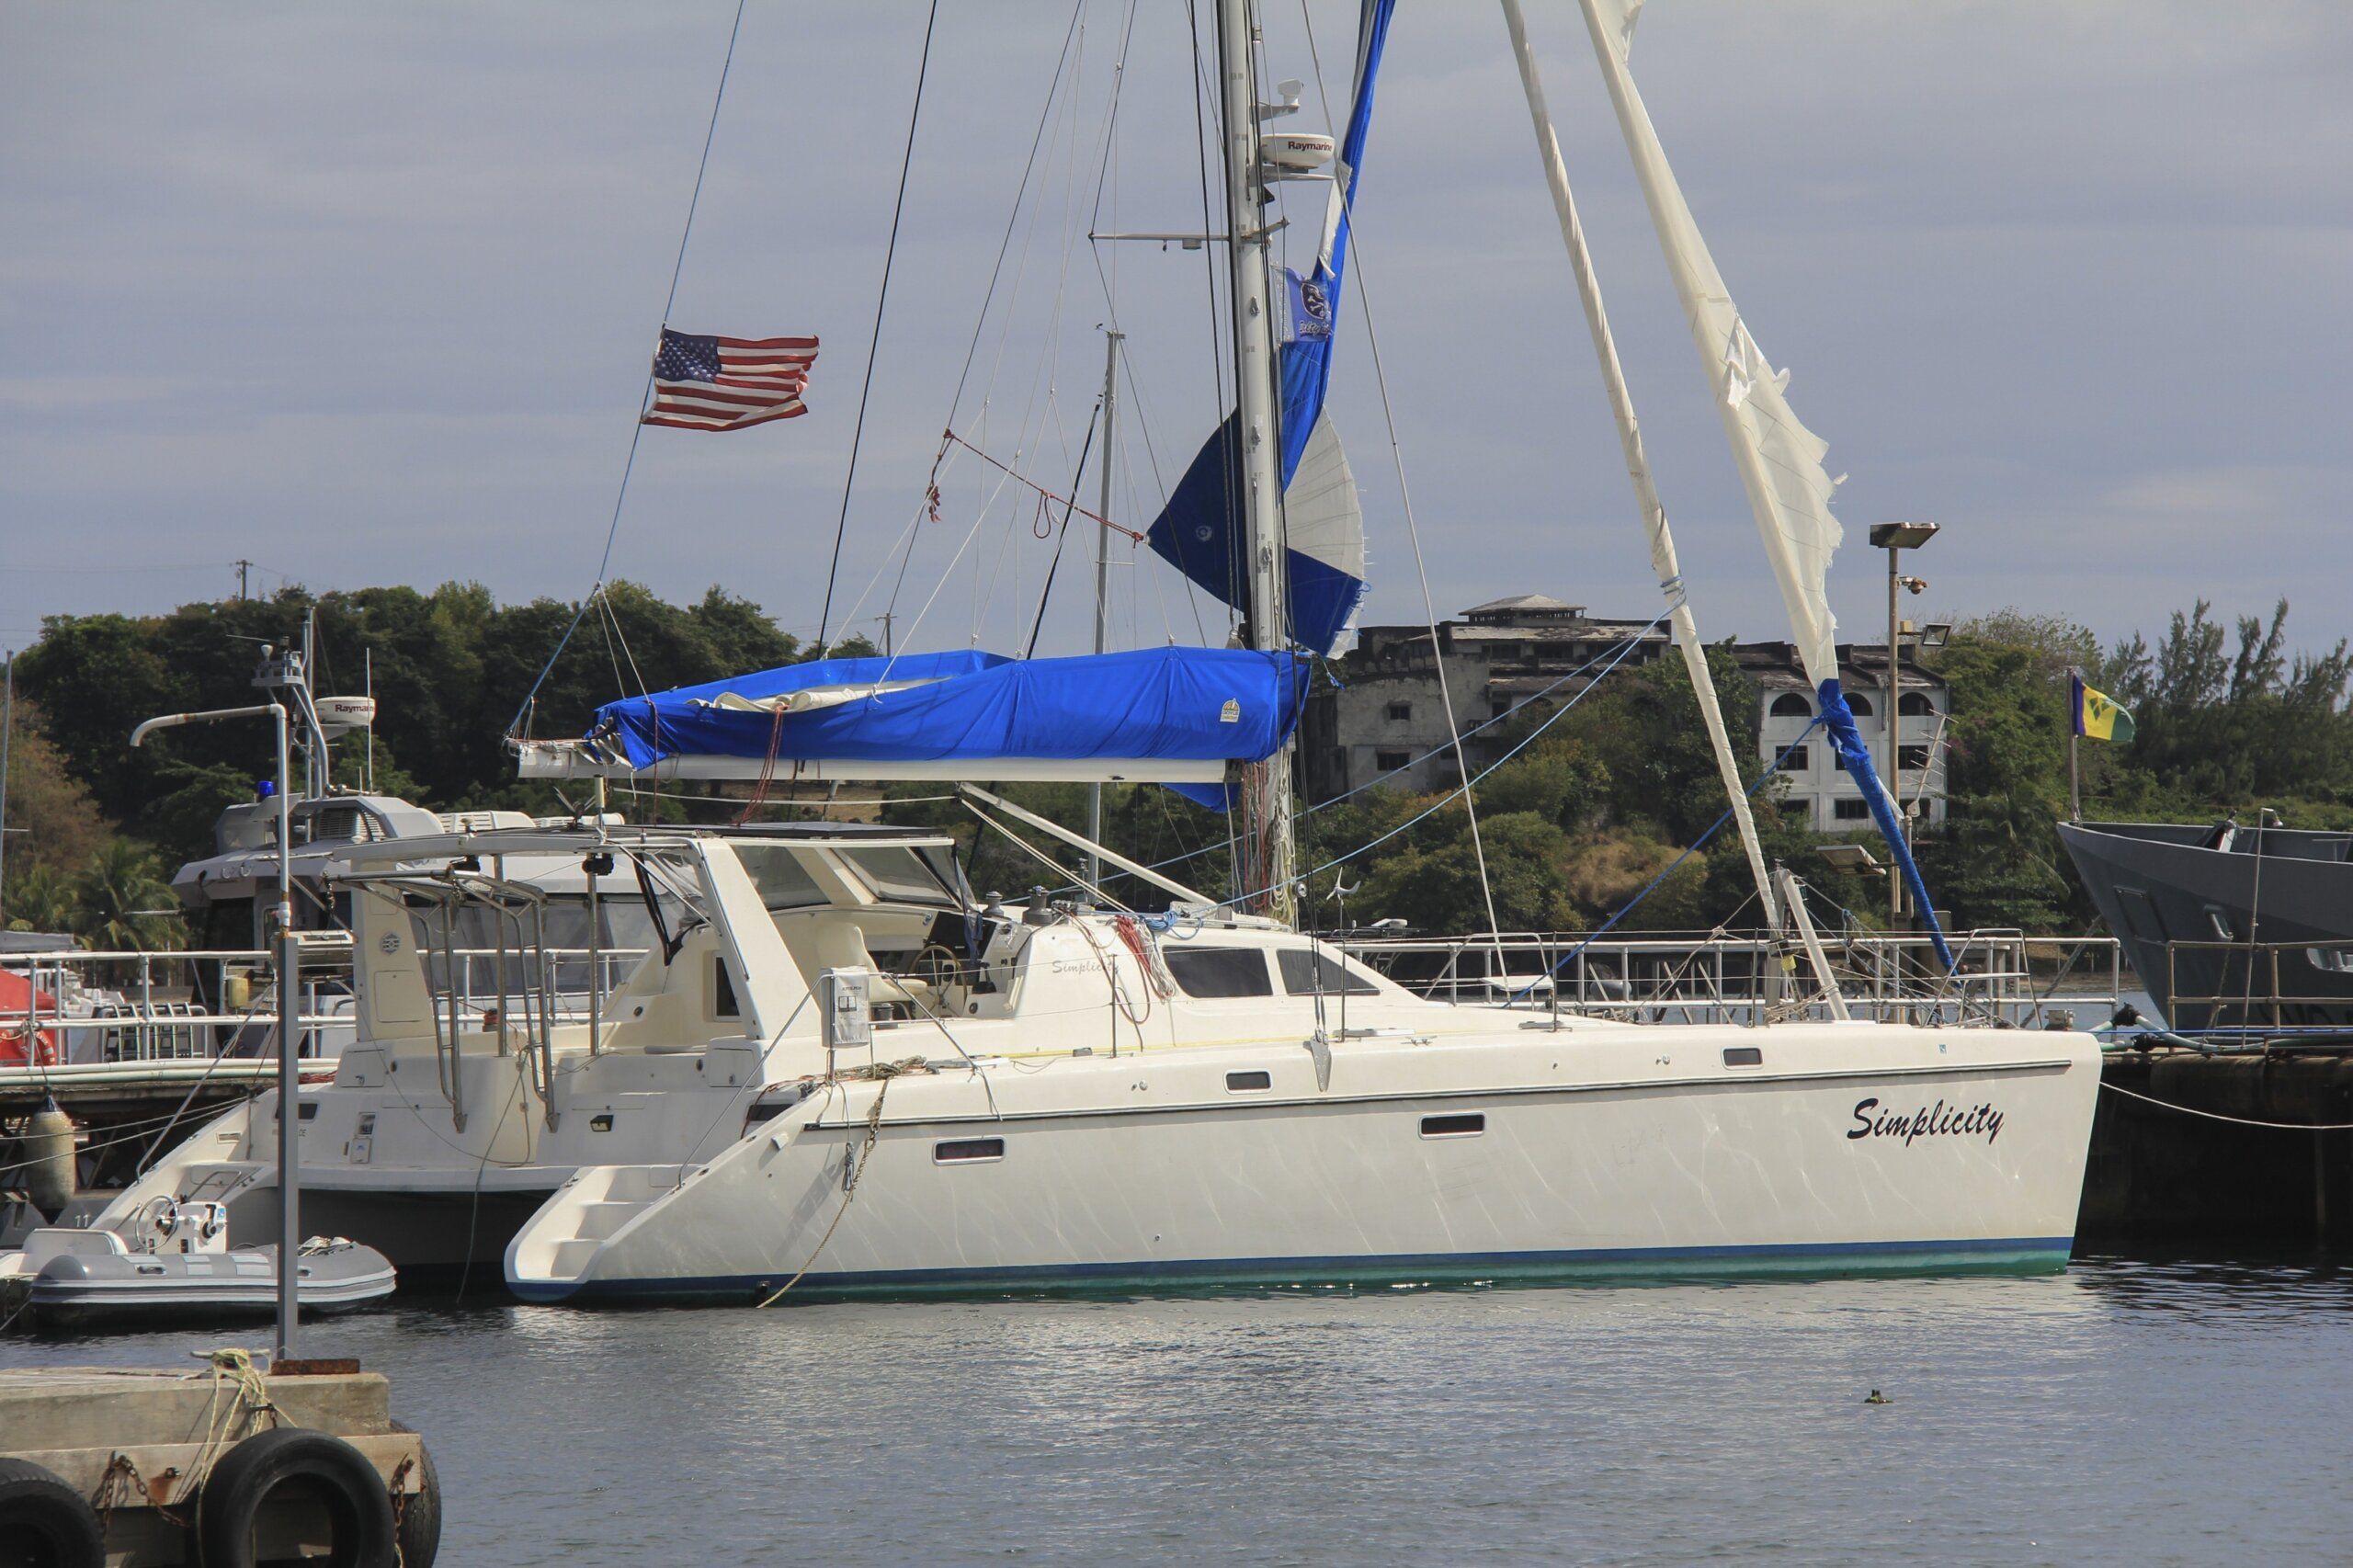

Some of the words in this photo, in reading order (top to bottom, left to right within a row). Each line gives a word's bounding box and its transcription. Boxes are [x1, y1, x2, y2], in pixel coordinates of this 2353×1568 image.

[1288, 141, 1333, 152] Raymarine
[335, 704, 375, 713] Raymarn
[1051, 960, 1121, 974] Simplicty
[1847, 1097, 2005, 1148] Simplicity
